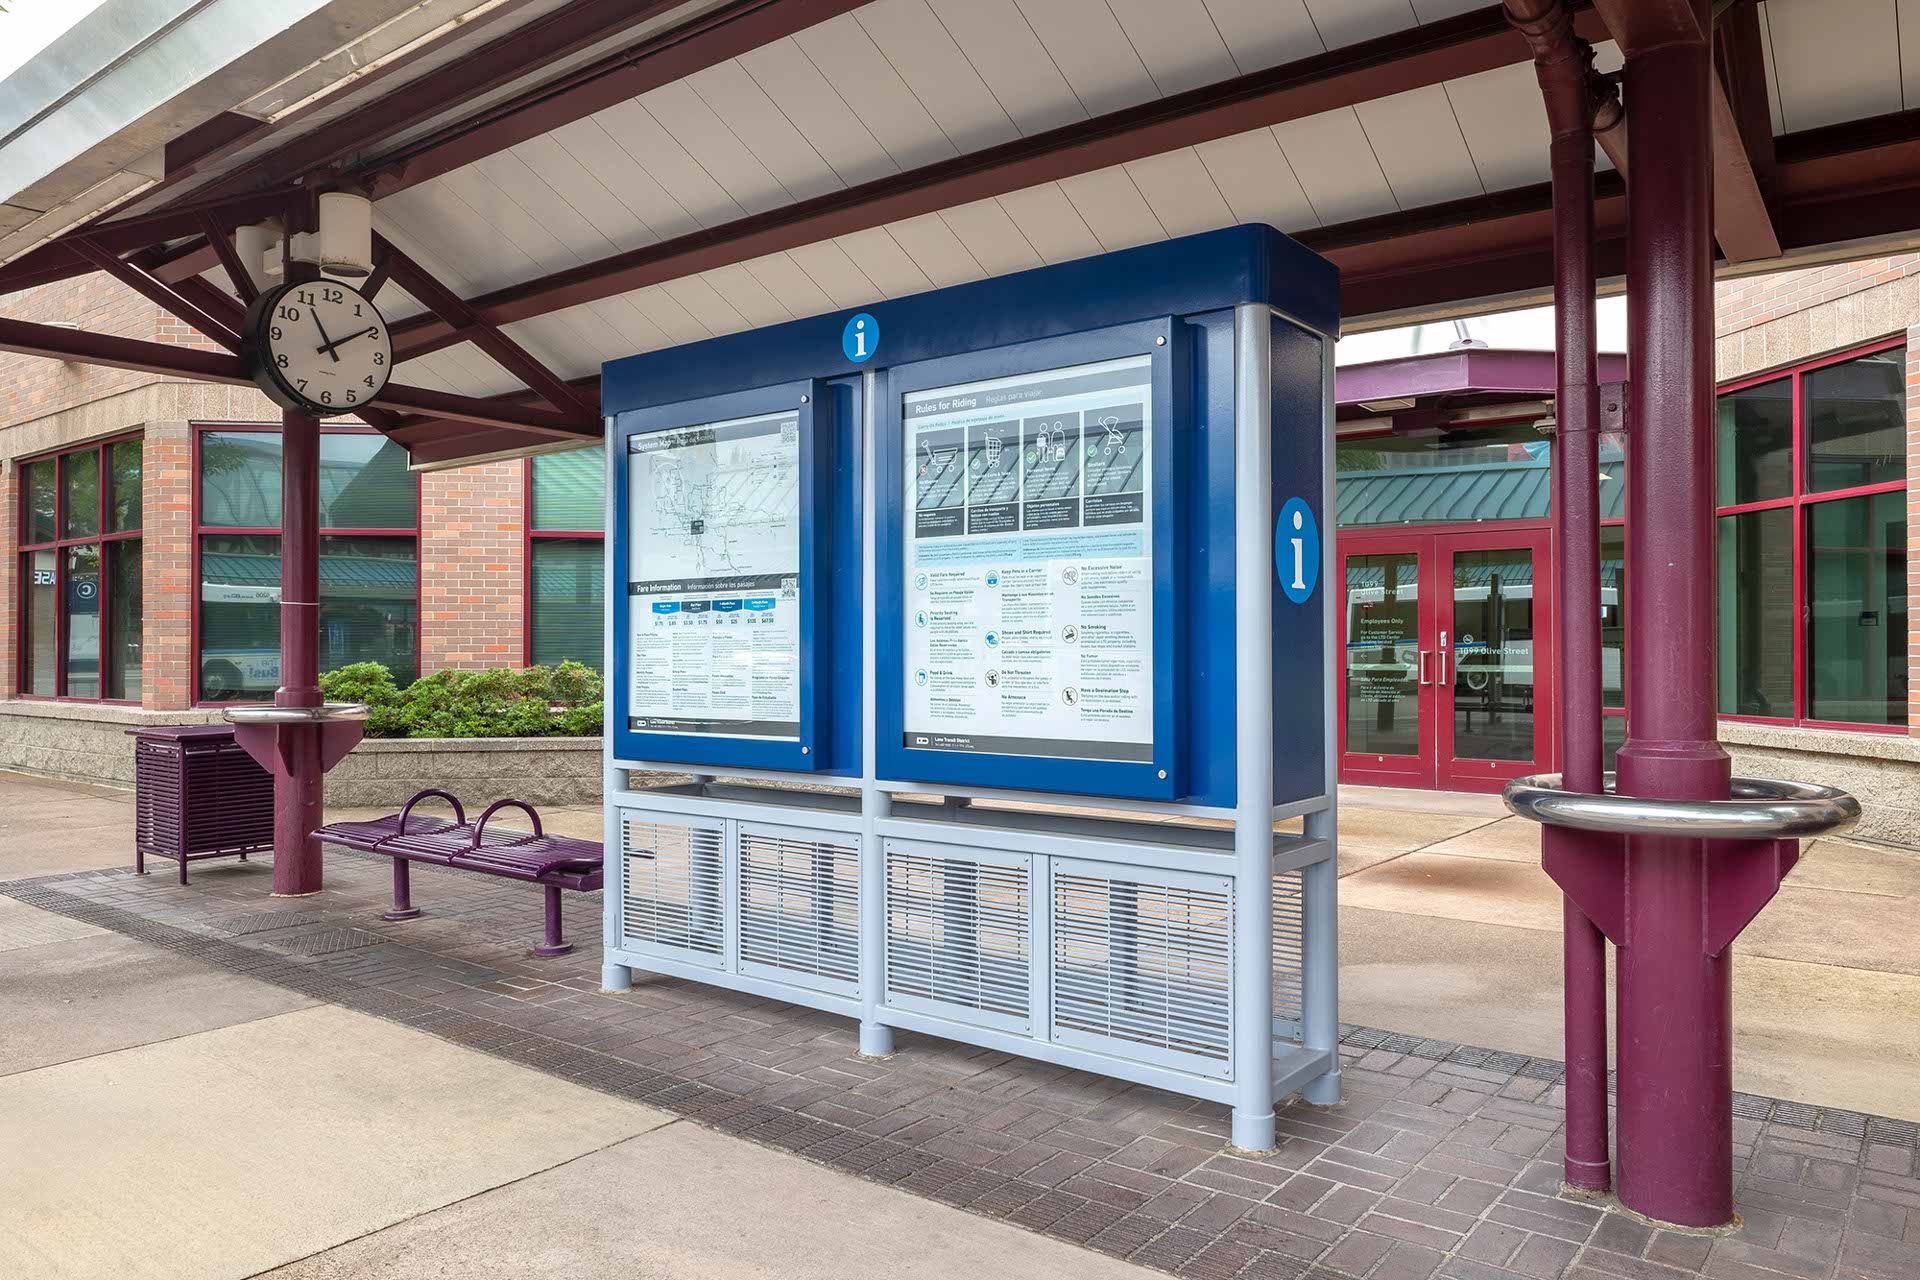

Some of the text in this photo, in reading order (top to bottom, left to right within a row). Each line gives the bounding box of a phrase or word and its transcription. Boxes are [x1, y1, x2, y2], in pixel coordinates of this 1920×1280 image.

[297, 290, 316, 307] 11
[322, 288, 343, 304] 12
[278, 305, 300, 322] 10
[354, 304, 362, 317] 1
[270, 327, 282, 340] 9
[367, 326, 379, 340] 2
[277, 354, 289, 368] 8
[373, 352, 384, 365] 3
[297, 378, 308, 392] 7
[363, 375, 375, 388] 4
[320, 391, 332, 404] 6
[346, 390, 357, 403] 5
[986, 390, 1042, 404] Reglas para viajar
[916, 397, 976, 413] Rules for Riding
[637, 440, 671, 451] System Map
[650, 583, 681, 592] Information
[737, 581, 755, 589] pasajes
[1481, 647, 1501, 655] Olive
[1504, 647, 1528, 655] Street
